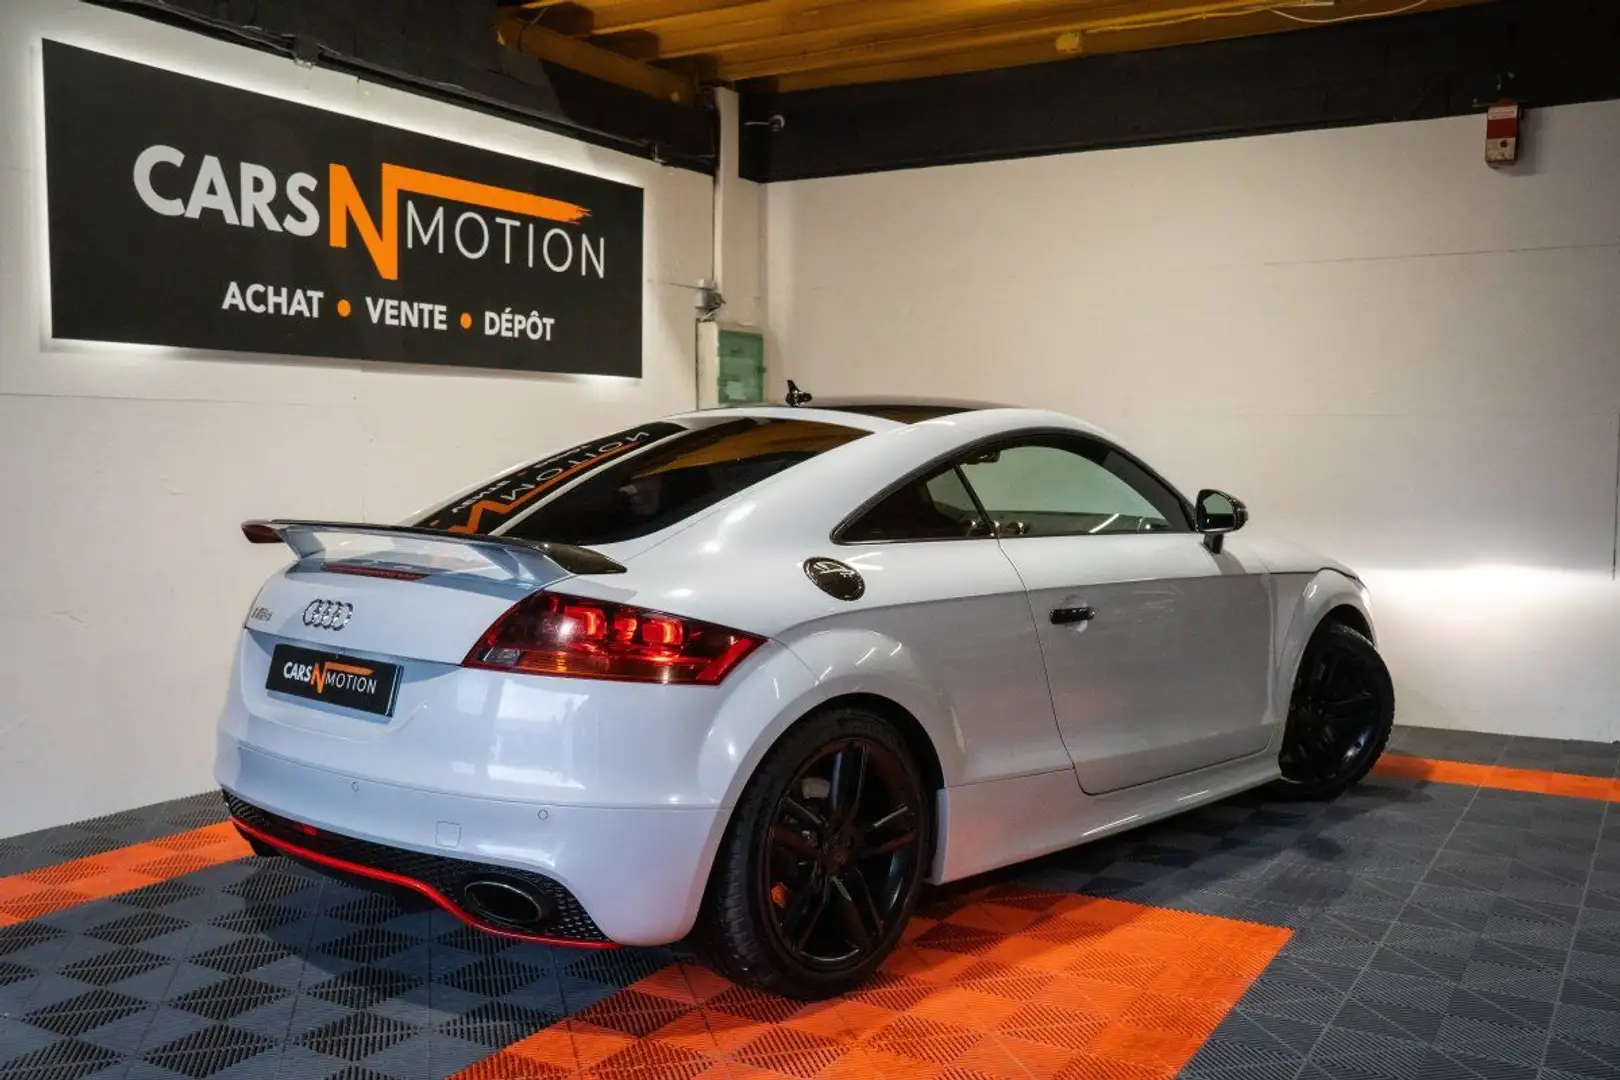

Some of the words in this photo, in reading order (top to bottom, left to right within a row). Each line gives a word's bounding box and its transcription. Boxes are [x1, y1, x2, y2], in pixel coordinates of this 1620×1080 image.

[134, 144, 320, 237] CARS
[407, 200, 605, 279] MOTION
[222, 281, 325, 319] ACHAT
[366, 296, 448, 331] VENTE
[484, 307, 555, 342] DÉPÔT
[283, 661, 311, 684] CARS
[325, 671, 377, 695] MOTION
